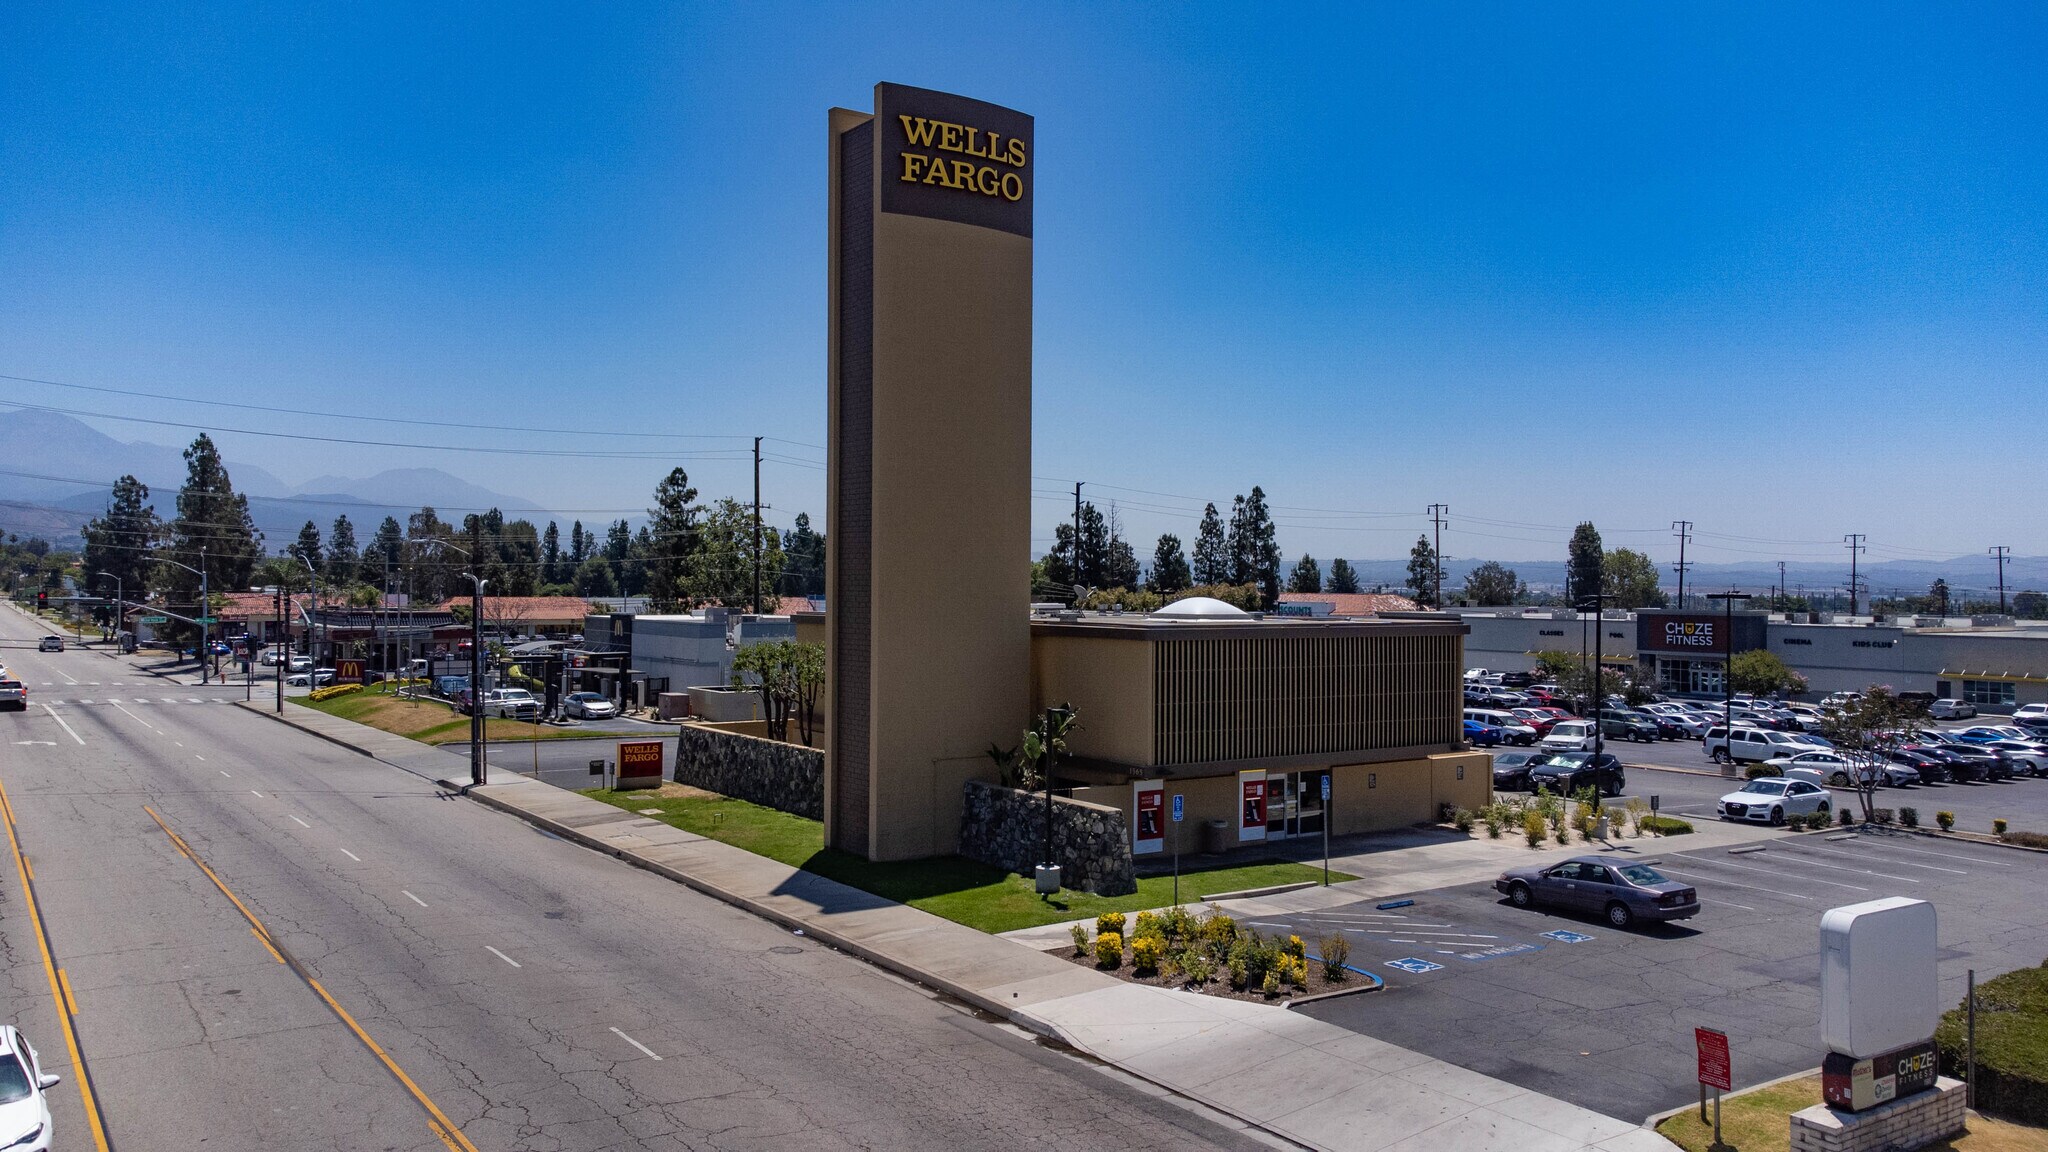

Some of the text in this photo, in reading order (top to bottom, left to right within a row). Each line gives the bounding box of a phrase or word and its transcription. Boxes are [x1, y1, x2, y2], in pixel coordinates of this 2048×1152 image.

[899, 114, 1026, 168] WELLS
[900, 152, 1024, 201] FARGO
[1665, 622, 1713, 635] CHUZE
[1666, 634, 1713, 646] FITNESS
[1783, 638, 1812, 646] CINEMA
[1852, 640, 1871, 648] KIDS
[624, 745, 659, 754] WELLS
[624, 753, 659, 762] FARGO
[1898, 1051, 1933, 1075] CHUZE
[1899, 1068, 1933, 1085] FITNESS
